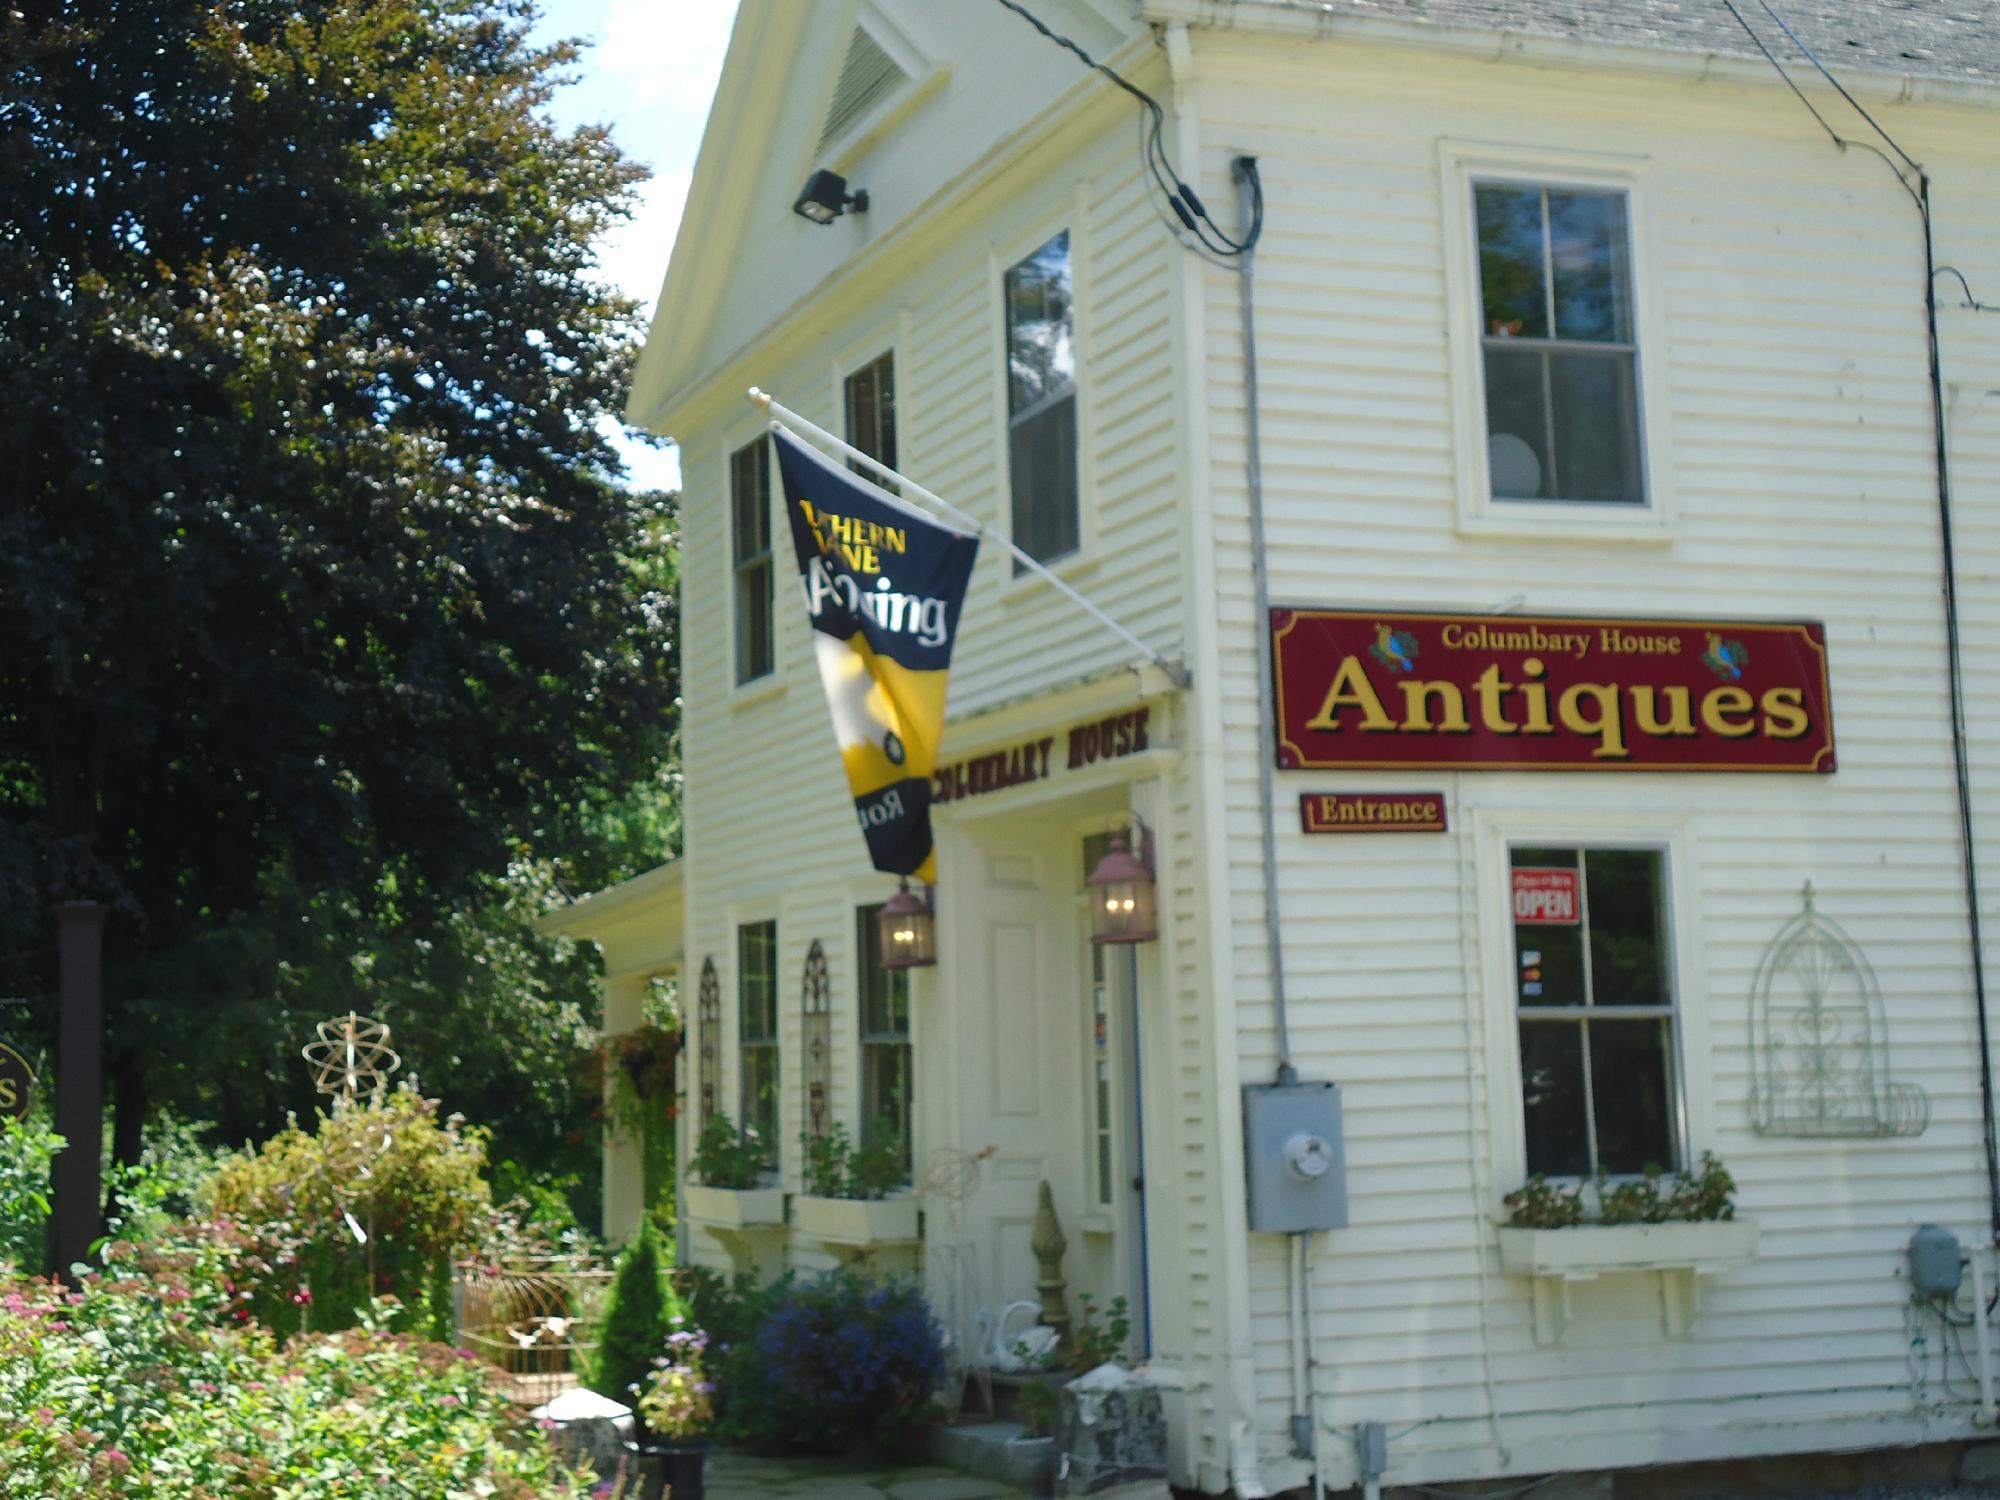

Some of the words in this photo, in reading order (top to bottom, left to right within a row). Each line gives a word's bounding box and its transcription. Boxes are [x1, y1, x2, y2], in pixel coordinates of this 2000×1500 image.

[1441, 624, 1592, 660] Columbary
[1599, 628, 1683, 654] House
[1305, 655, 1811, 758] Antiques
[1067, 706, 1150, 770] HOUSE
[1321, 795, 1438, 823] Entrance
[1515, 888, 1573, 917] OPEN
